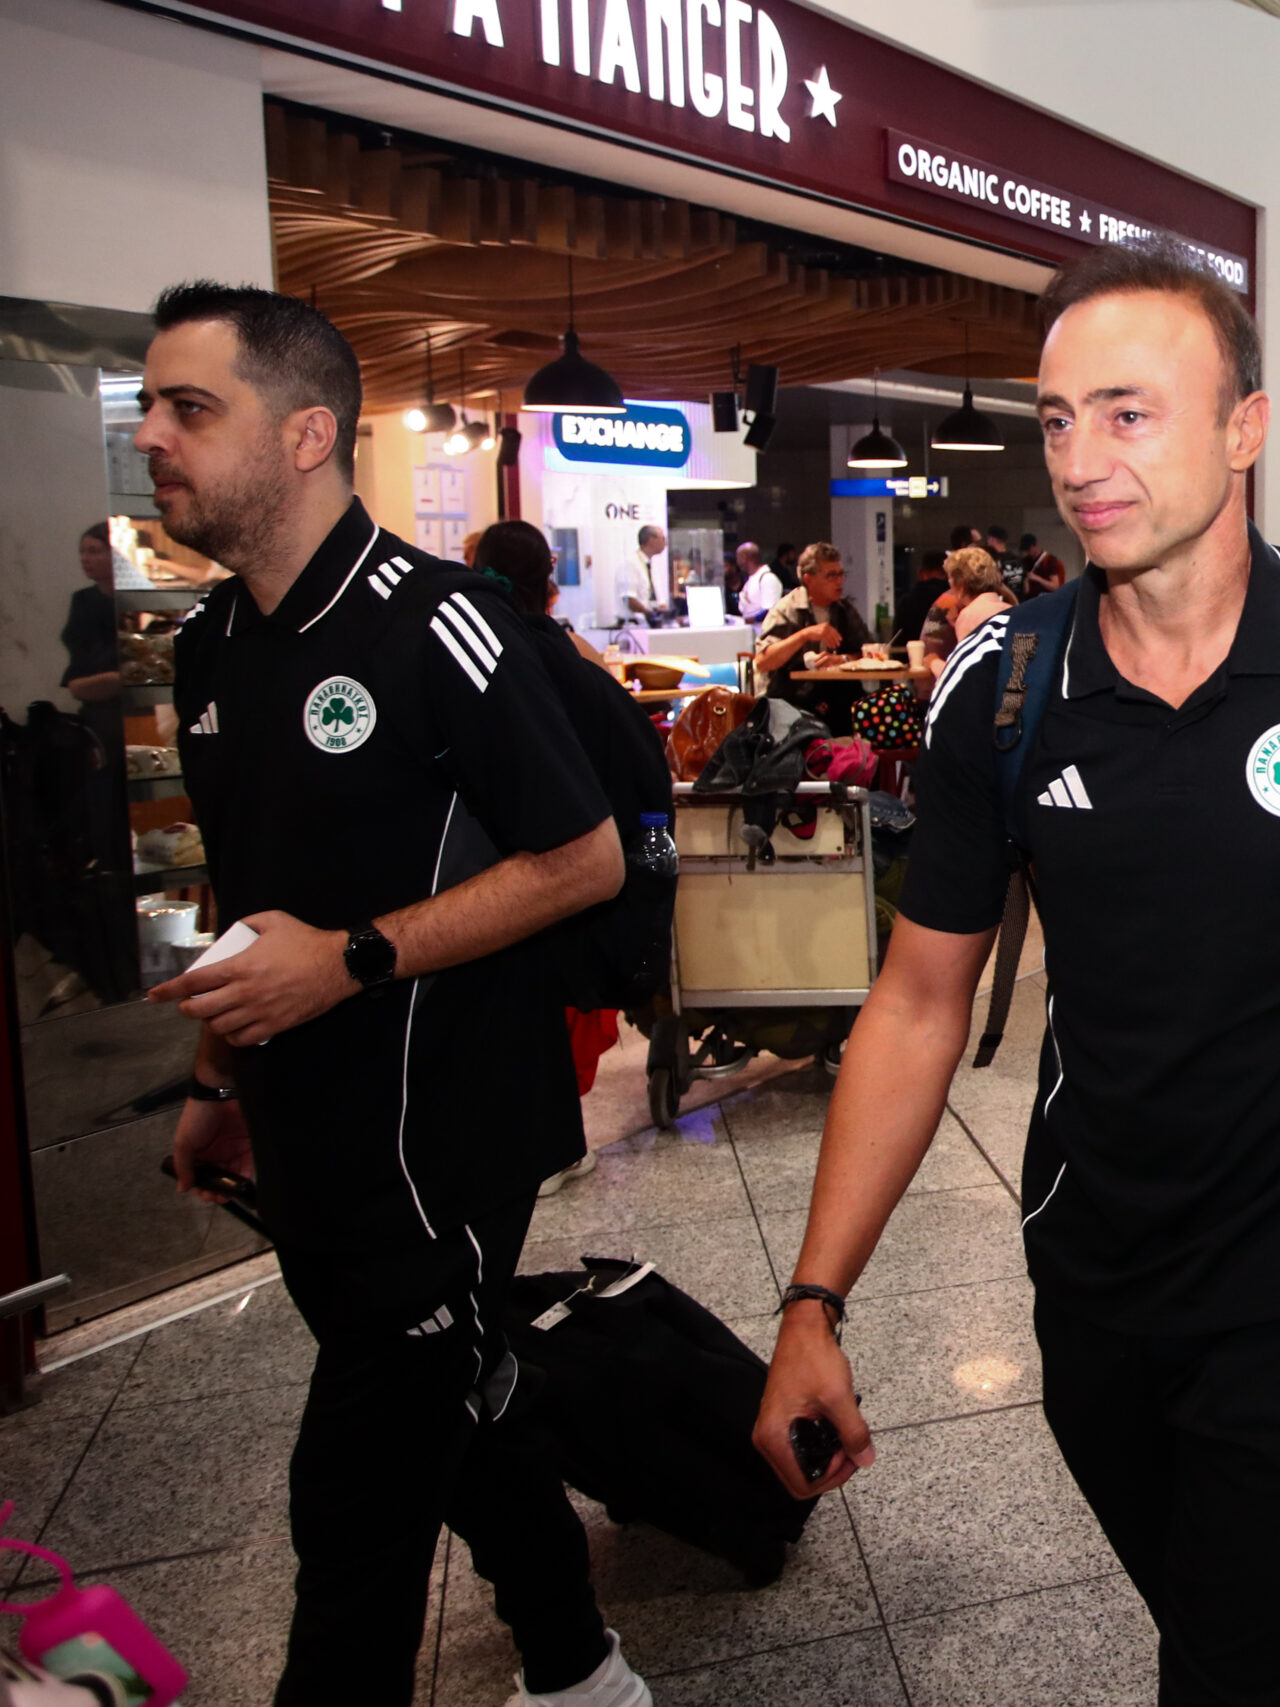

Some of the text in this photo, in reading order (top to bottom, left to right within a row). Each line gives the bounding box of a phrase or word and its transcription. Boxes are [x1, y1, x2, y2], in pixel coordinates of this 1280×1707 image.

[898, 143, 1000, 205] ORGANIC
[1003, 180, 1072, 229] COFFEE
[561, 414, 684, 453] EXCHANGE
